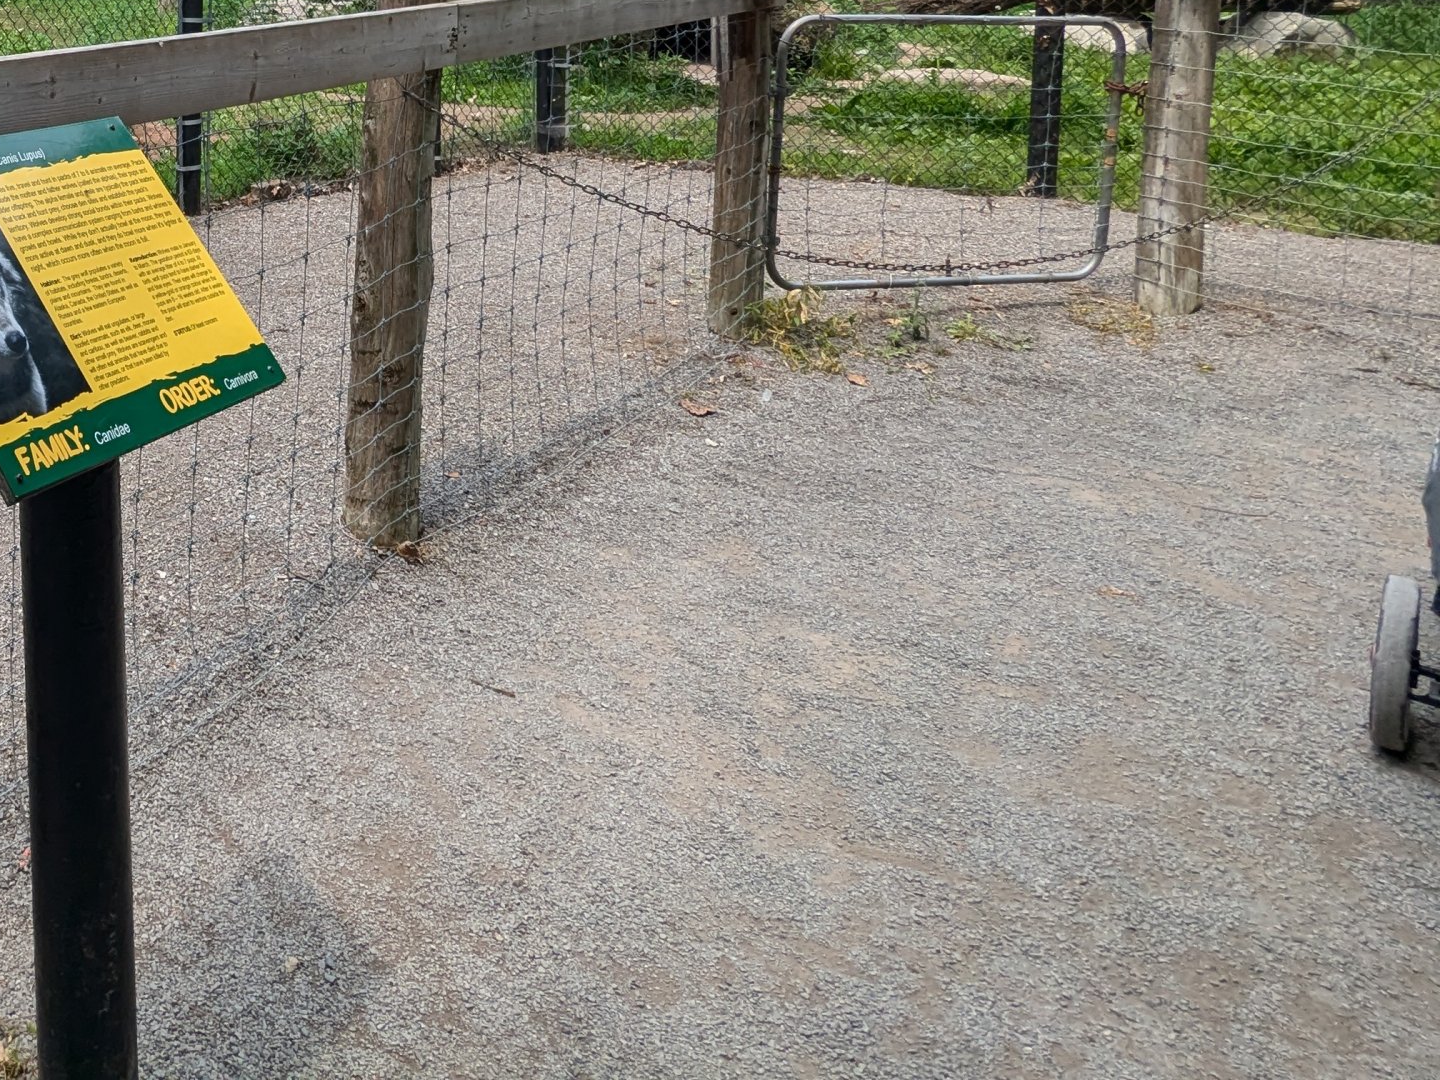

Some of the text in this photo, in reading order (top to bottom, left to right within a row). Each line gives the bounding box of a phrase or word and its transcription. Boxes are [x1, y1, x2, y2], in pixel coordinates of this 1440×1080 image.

[19, 147, 46, 165] Lupus)
[159, 369, 259, 414] ORDER: Carnivora
[14, 422, 131, 476] FAMILY: Canidae
